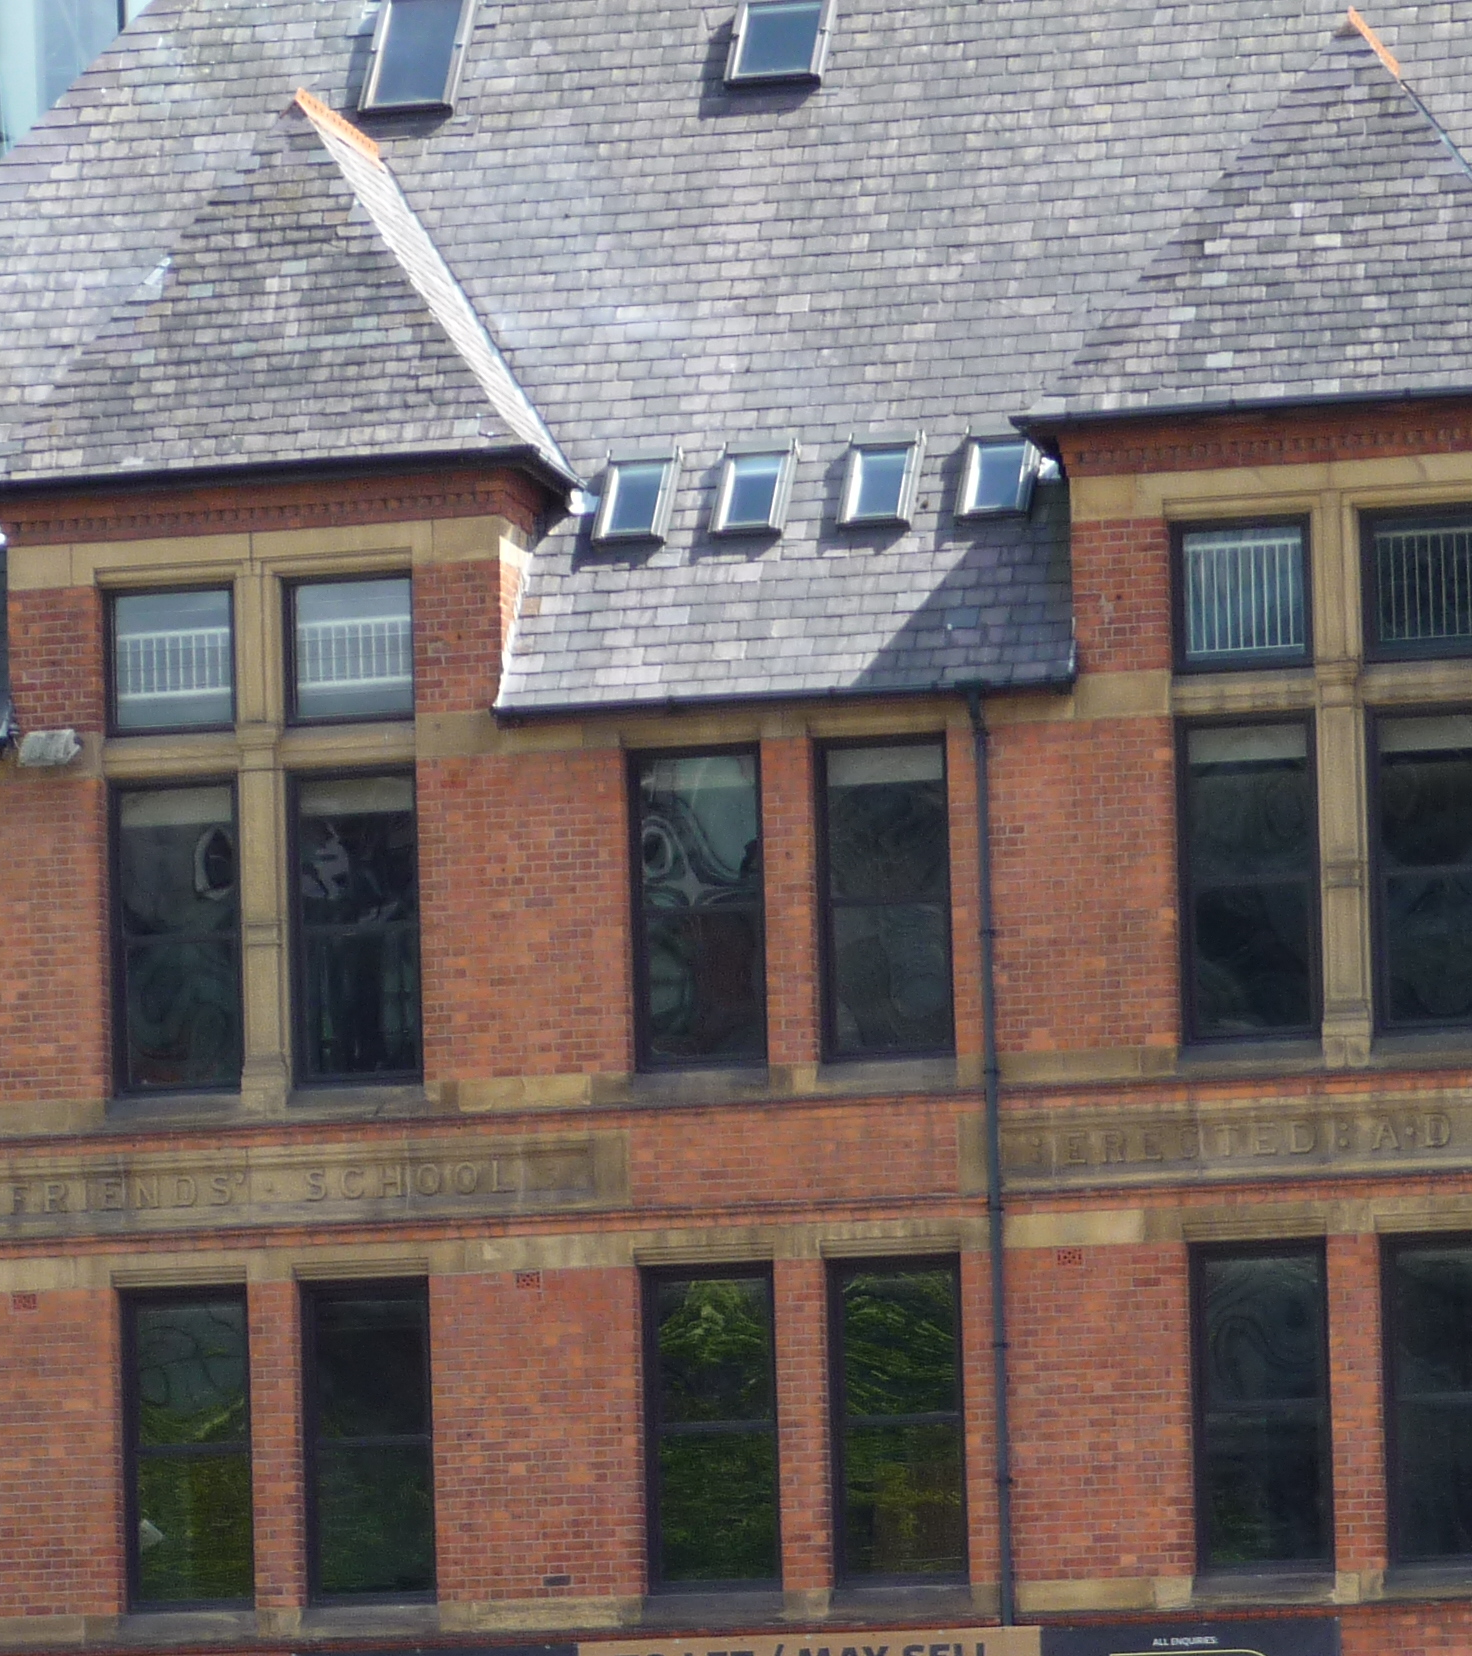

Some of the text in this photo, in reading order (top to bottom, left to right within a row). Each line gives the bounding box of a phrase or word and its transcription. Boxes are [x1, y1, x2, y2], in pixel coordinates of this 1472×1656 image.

[1064, 1121, 1318, 1166] ERECTED
[305, 1160, 517, 1203] SCHOOL
[1152, 1637, 1169, 1647] ALL
